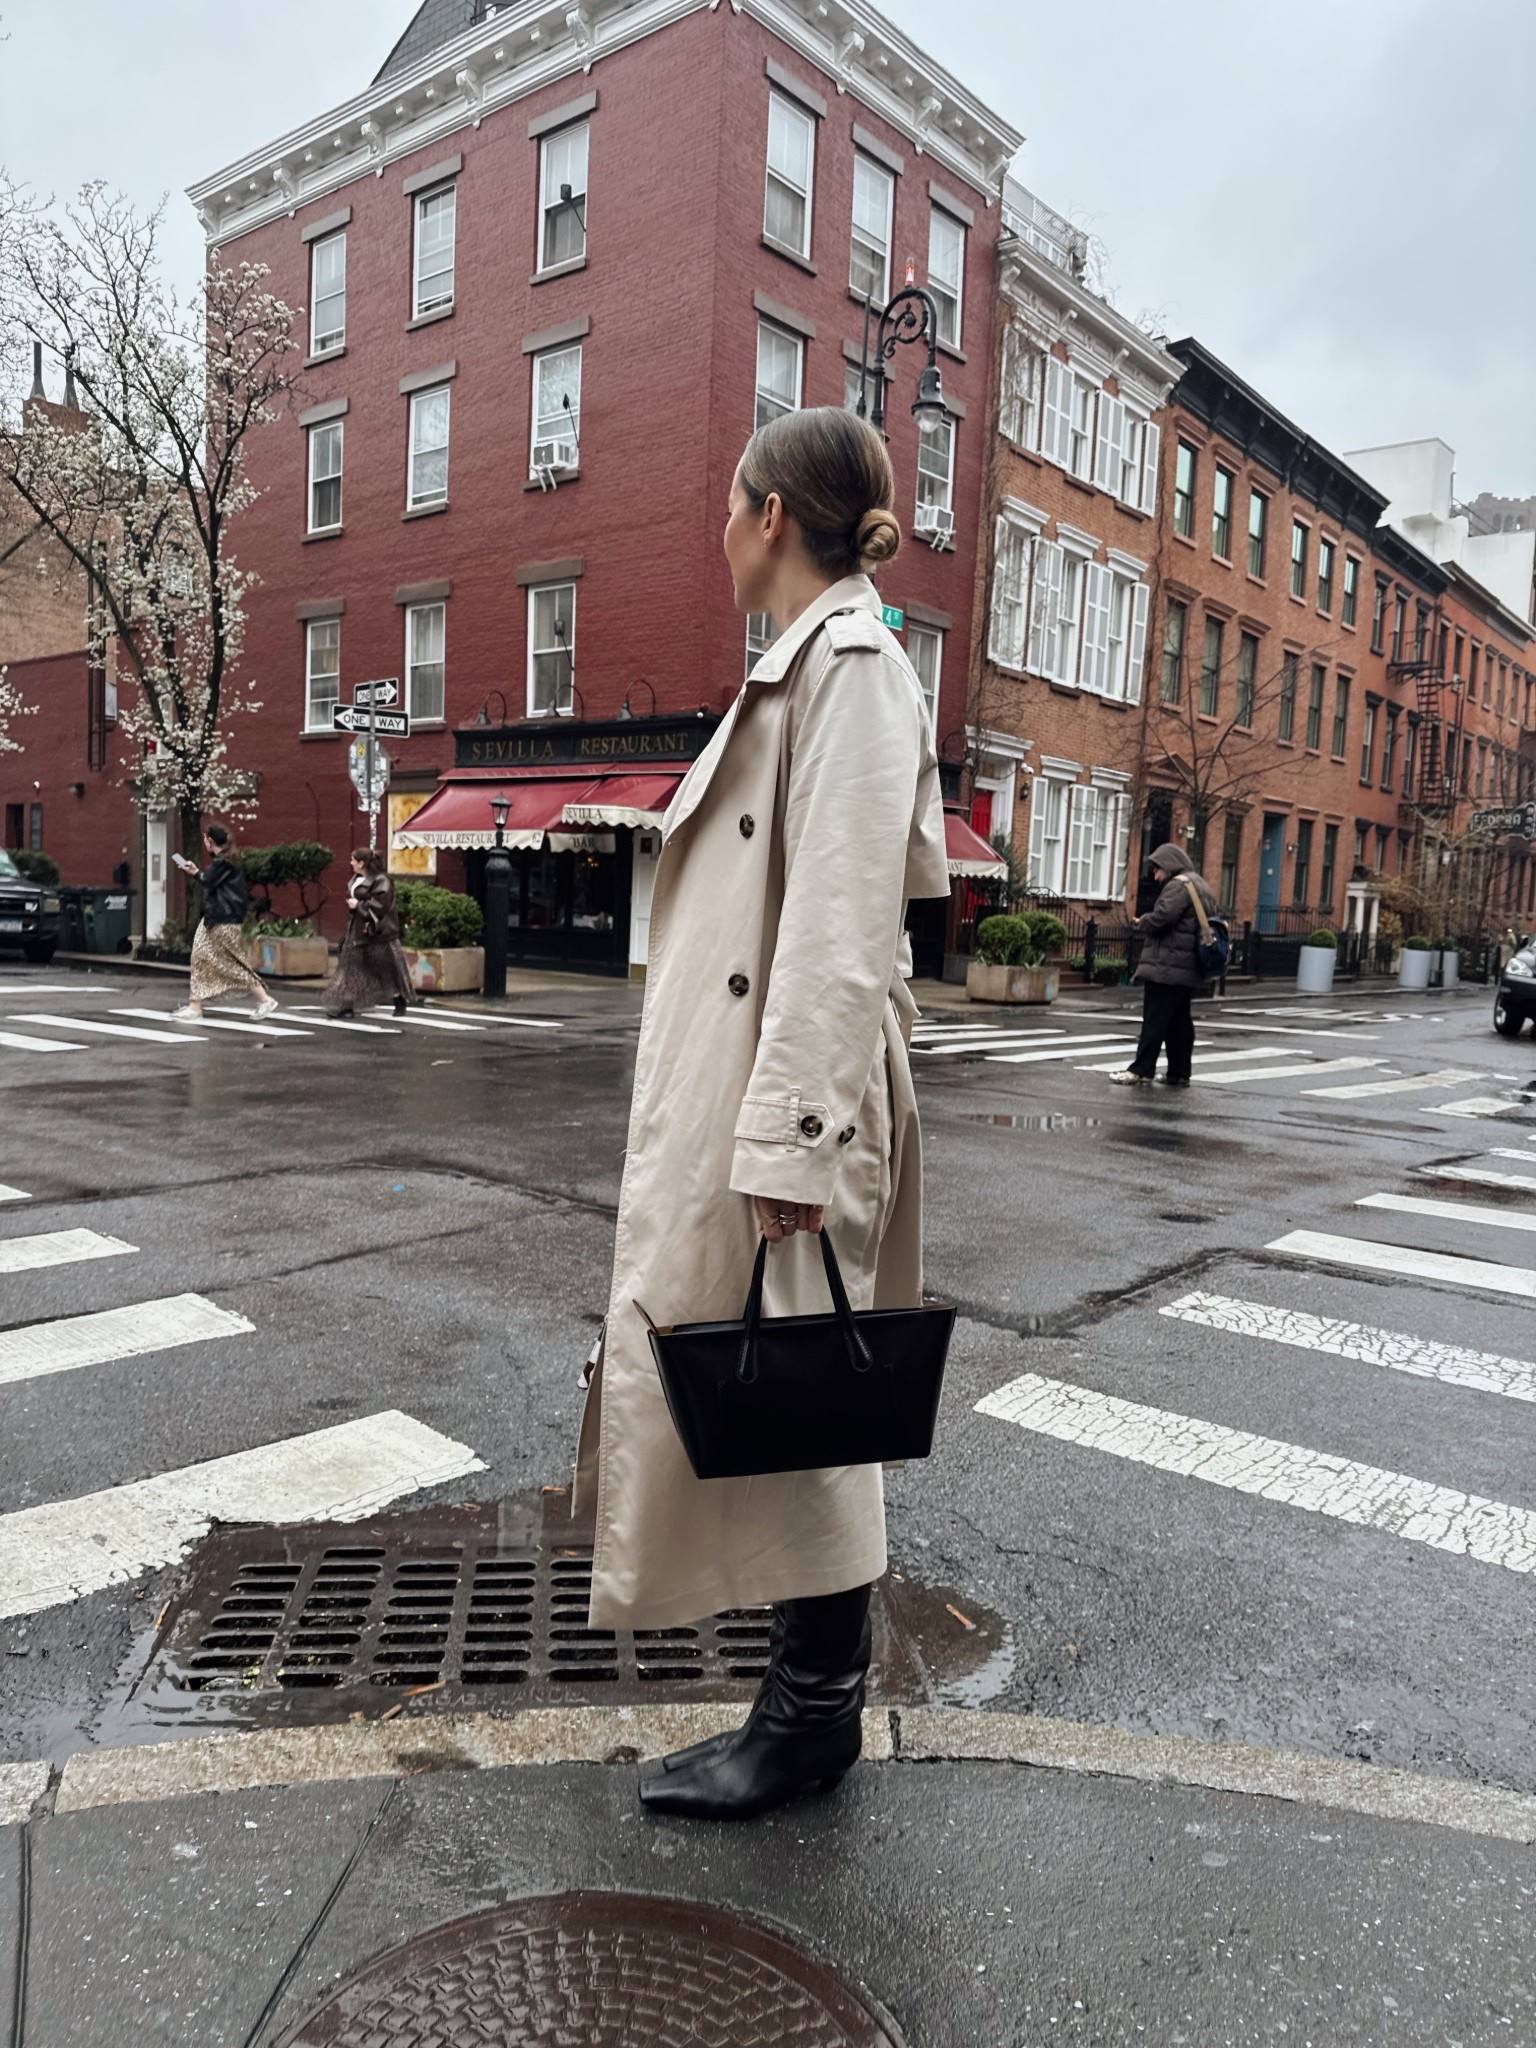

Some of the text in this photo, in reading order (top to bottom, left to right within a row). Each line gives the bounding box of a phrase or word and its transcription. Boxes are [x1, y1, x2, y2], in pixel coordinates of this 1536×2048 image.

[359, 688, 391, 702] ONE WAY
[343, 713, 401, 729] ONE WAY
[472, 733, 688, 761] SEVILLA RESTAURANT
[564, 807, 603, 819] SEVILLA
[423, 833, 454, 844] SEVILLA
[573, 837, 595, 849] BAR
